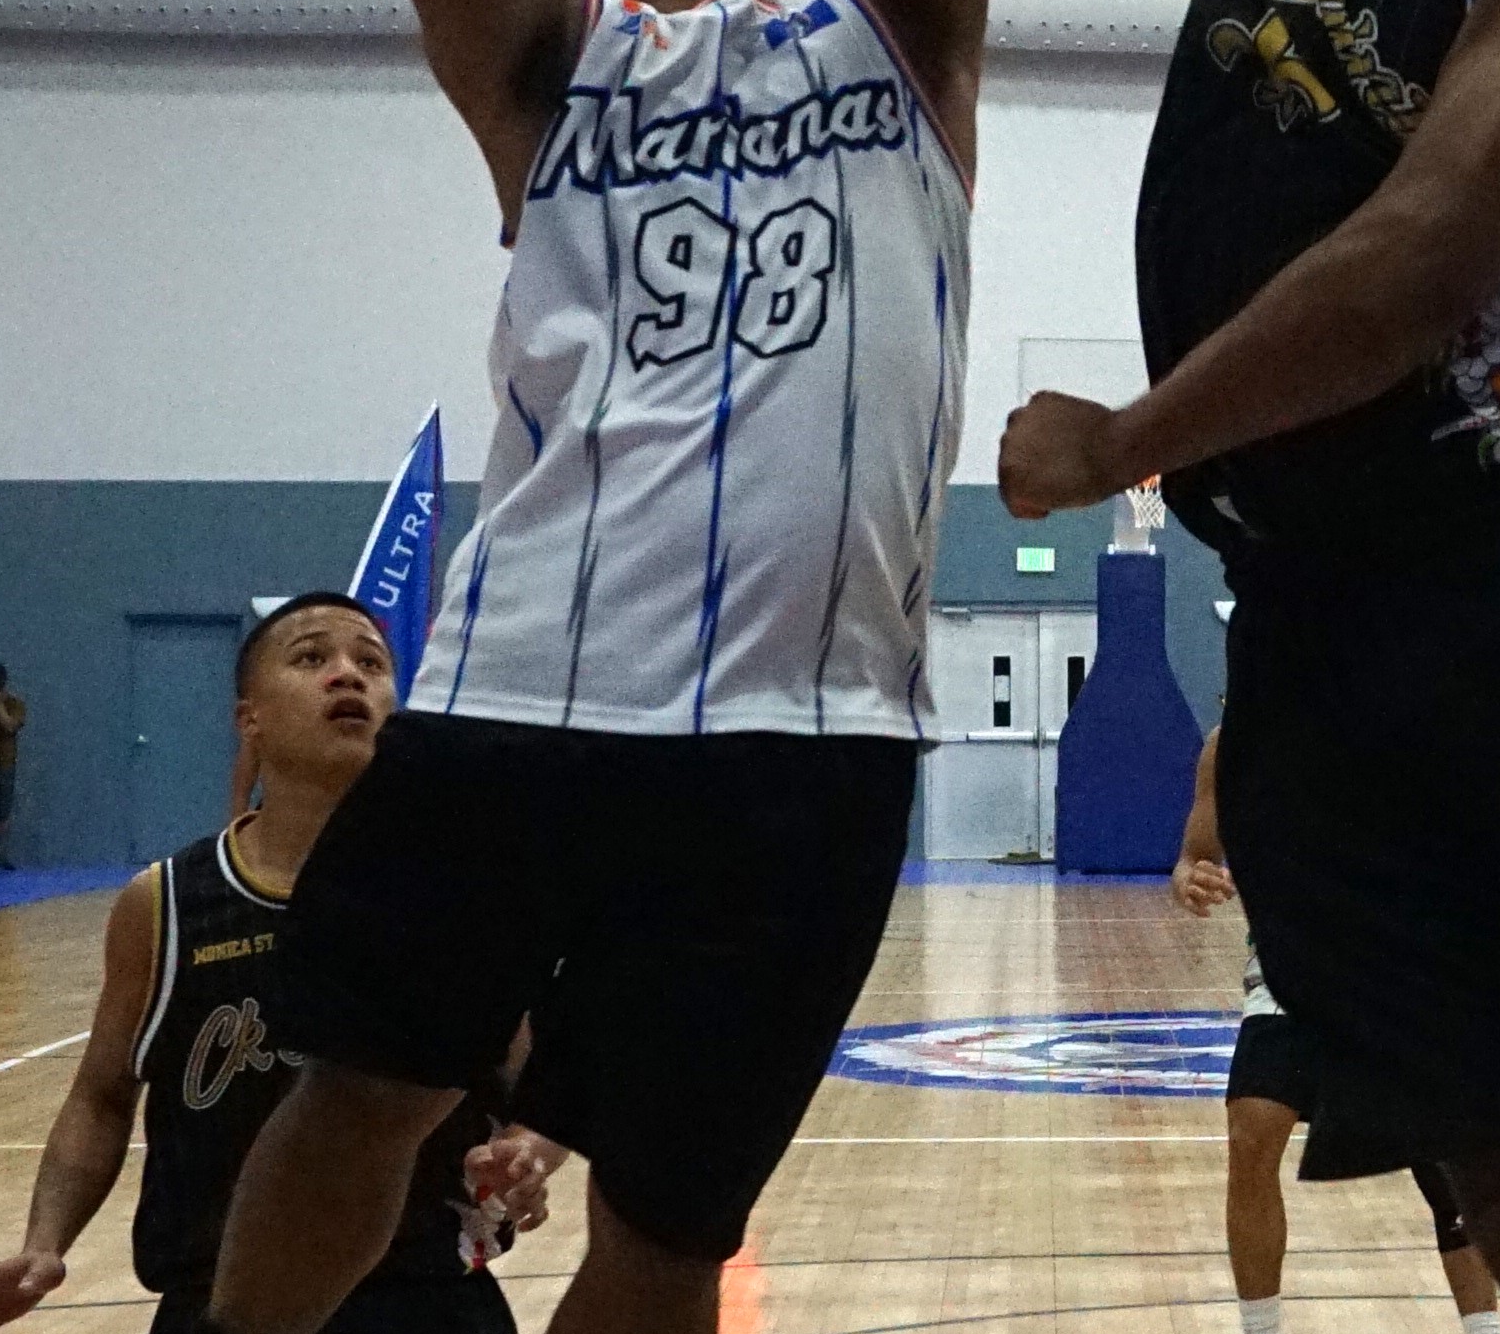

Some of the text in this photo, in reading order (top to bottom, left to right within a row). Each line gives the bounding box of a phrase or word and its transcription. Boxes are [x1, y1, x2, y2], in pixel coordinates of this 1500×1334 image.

[528, 81, 908, 200] Marianas
[627, 196, 838, 374] 98
[373, 489, 434, 610] ULTRA
